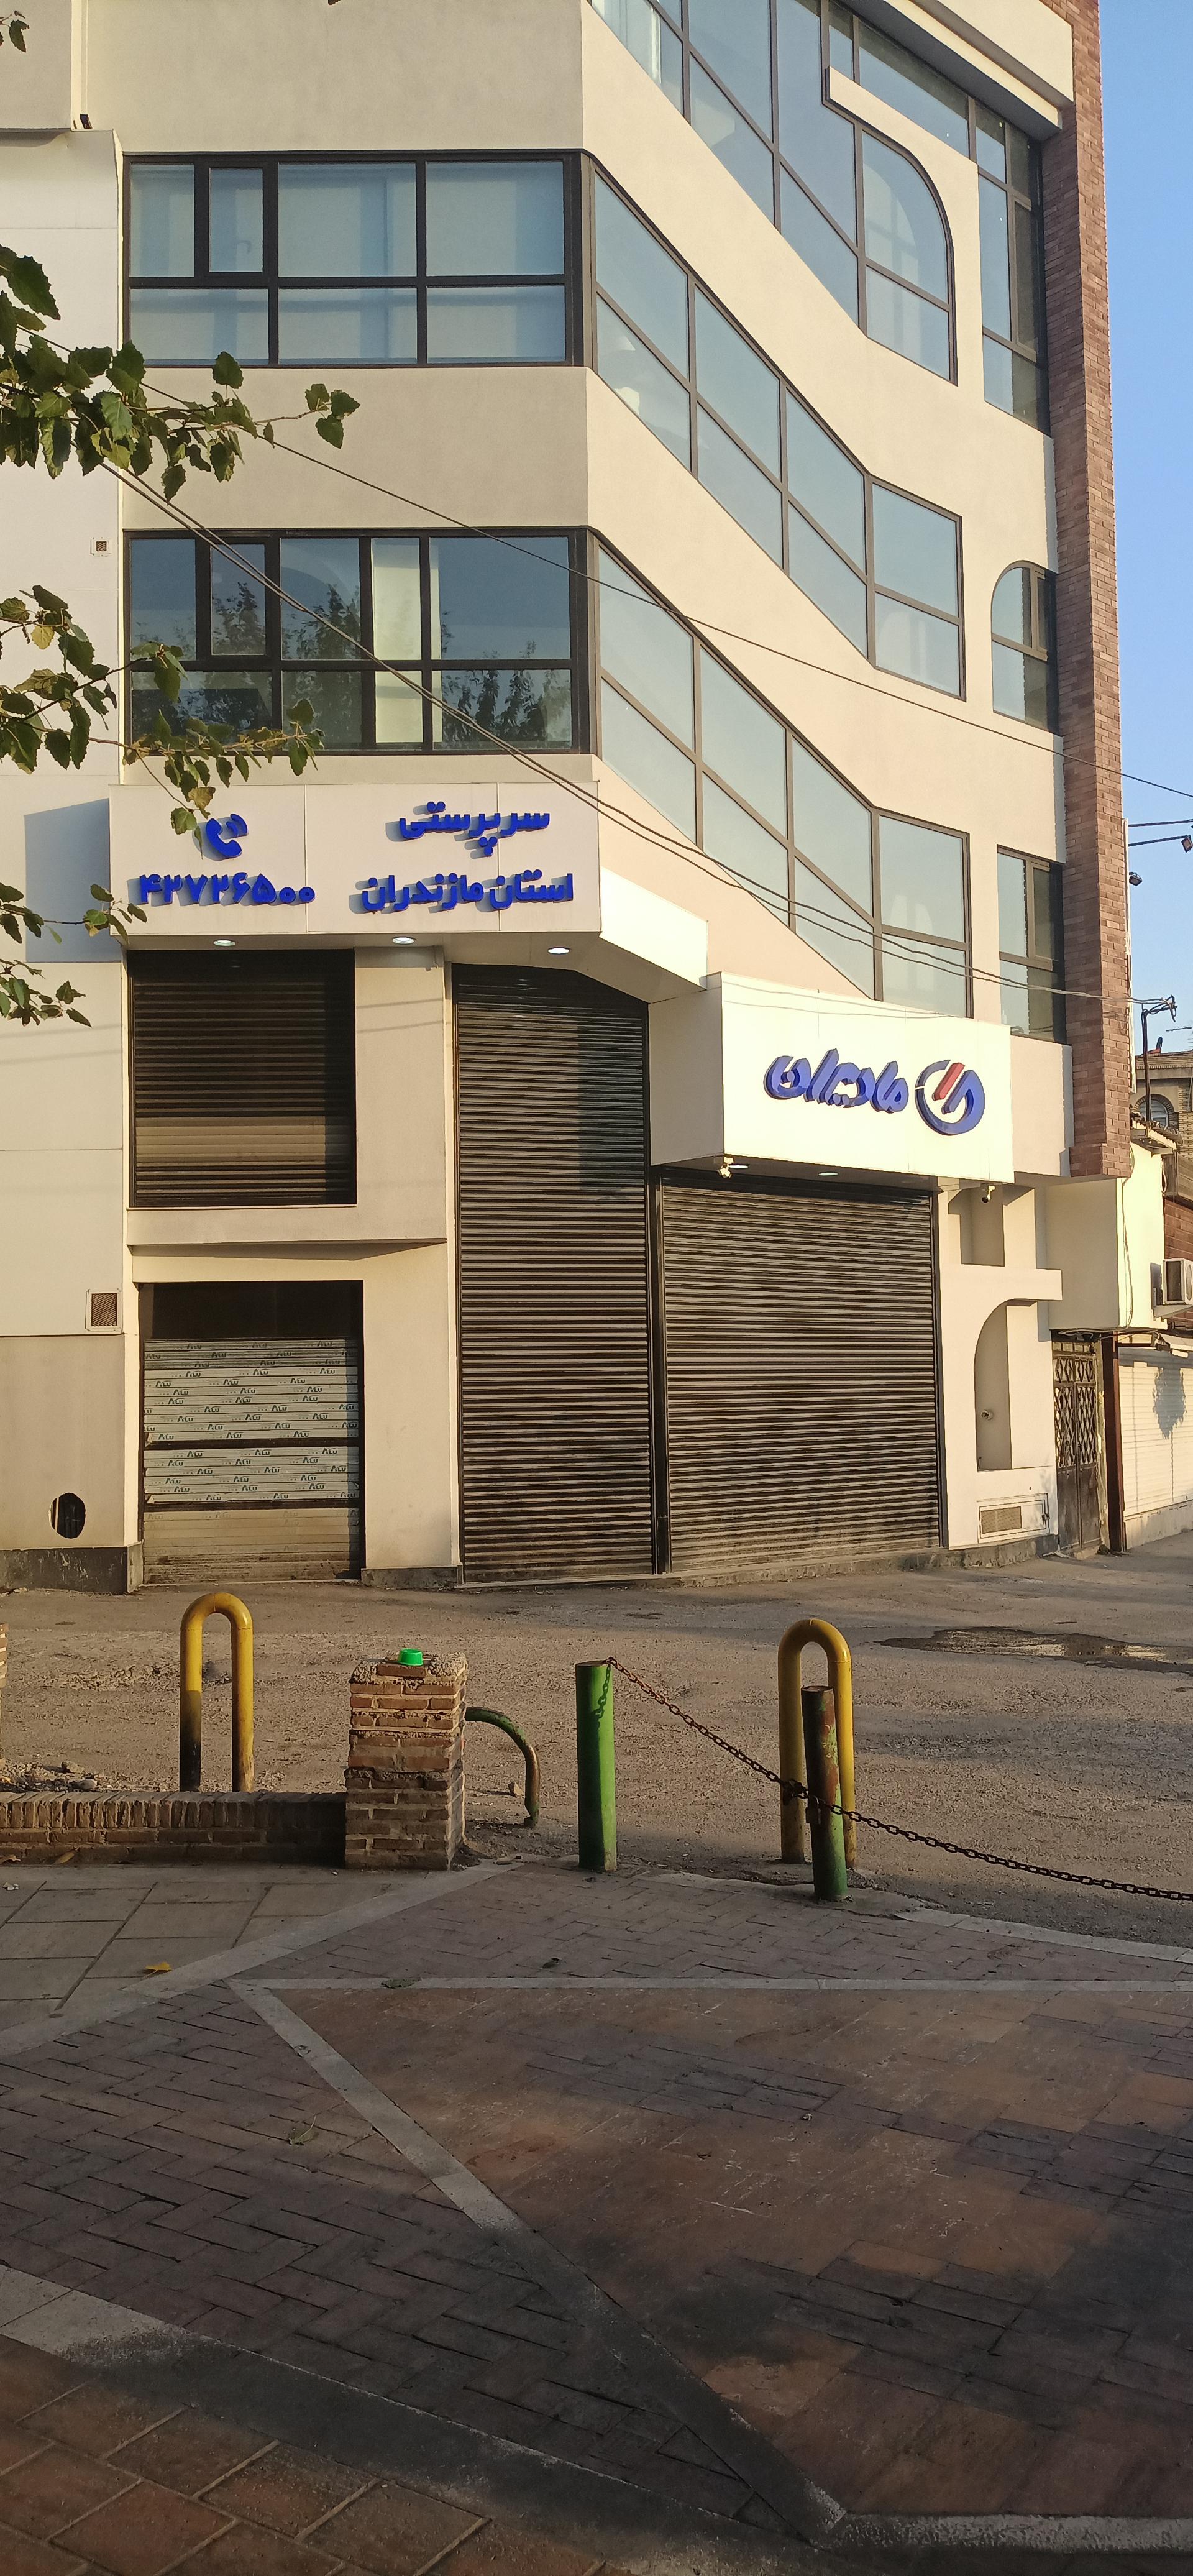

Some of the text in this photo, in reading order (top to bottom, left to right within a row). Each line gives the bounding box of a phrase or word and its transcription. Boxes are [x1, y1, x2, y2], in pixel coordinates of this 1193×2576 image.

[399, 801, 550, 856] سرپرستی
[139, 872, 316, 904] ۴۲۷۲۶۵۰۰
[362, 869, 574, 912] استان مازندران
